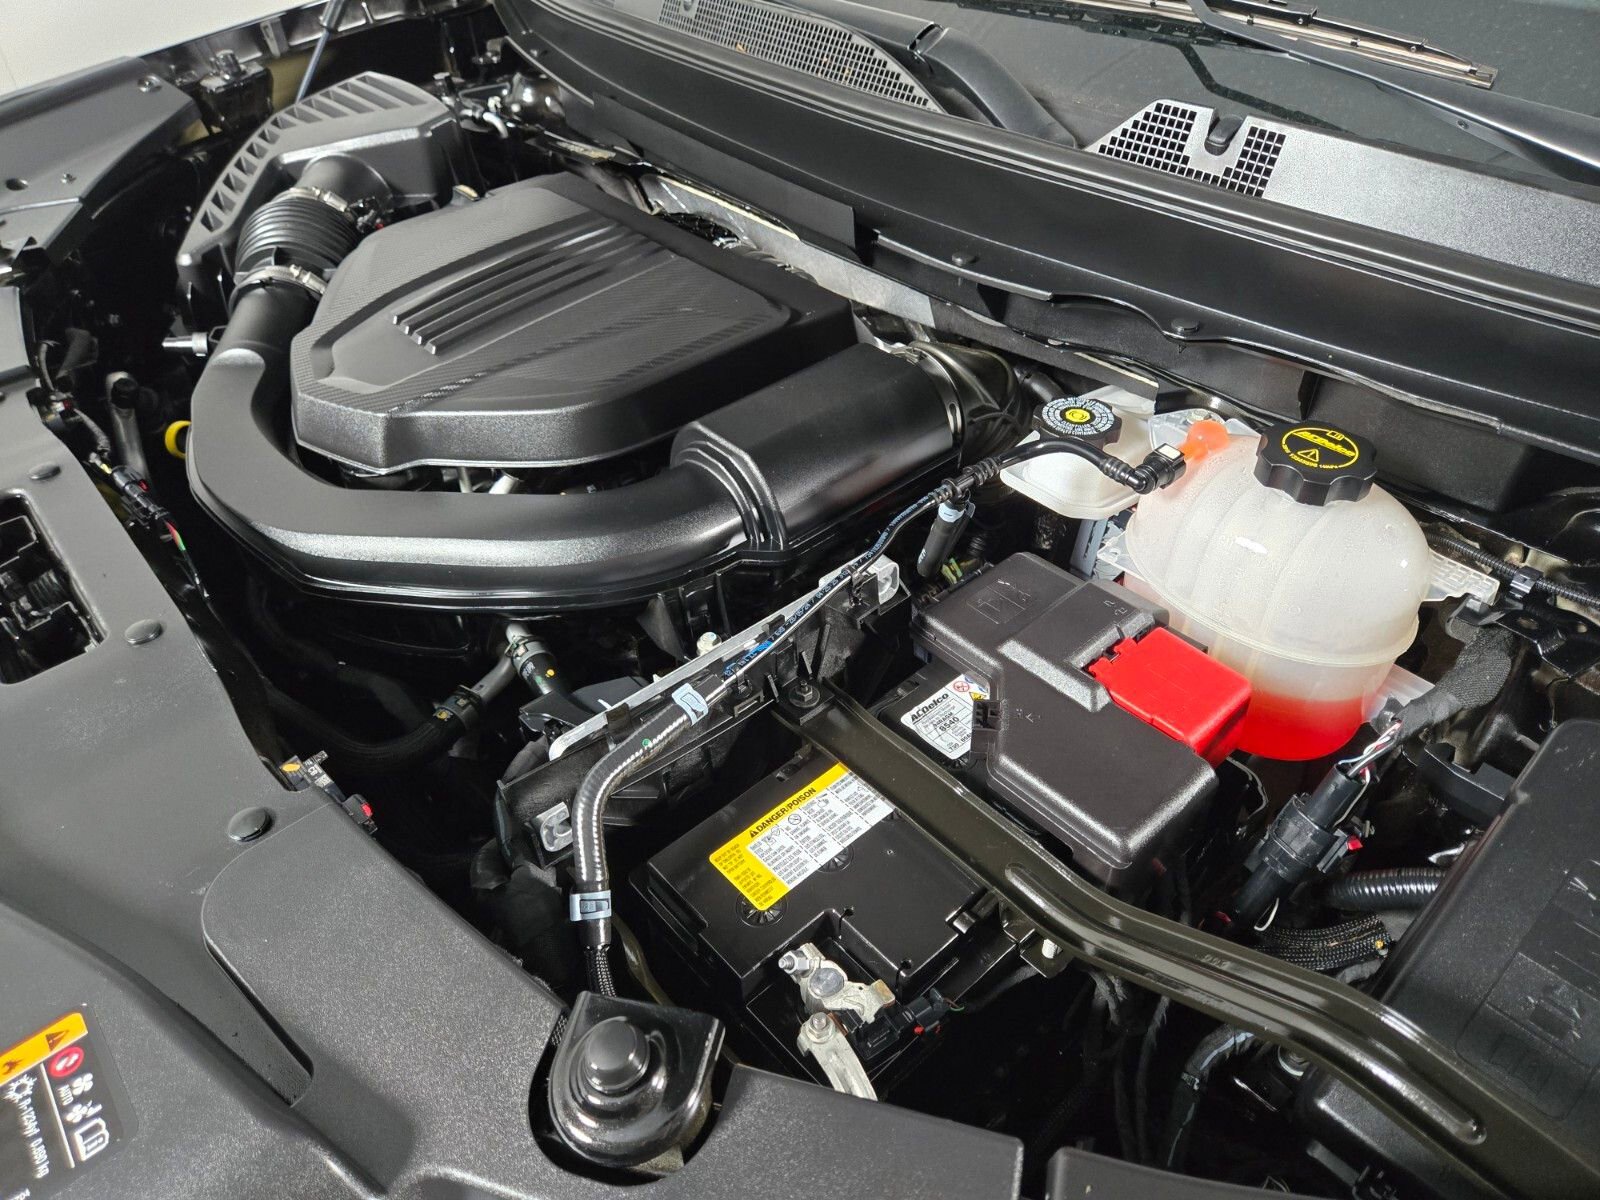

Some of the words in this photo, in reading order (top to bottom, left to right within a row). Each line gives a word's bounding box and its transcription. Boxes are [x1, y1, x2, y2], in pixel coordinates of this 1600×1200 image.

[911, 693, 949, 722] ACDelco
[939, 716, 960, 732] 8540
[757, 787, 816, 832] DANGER/POISON
